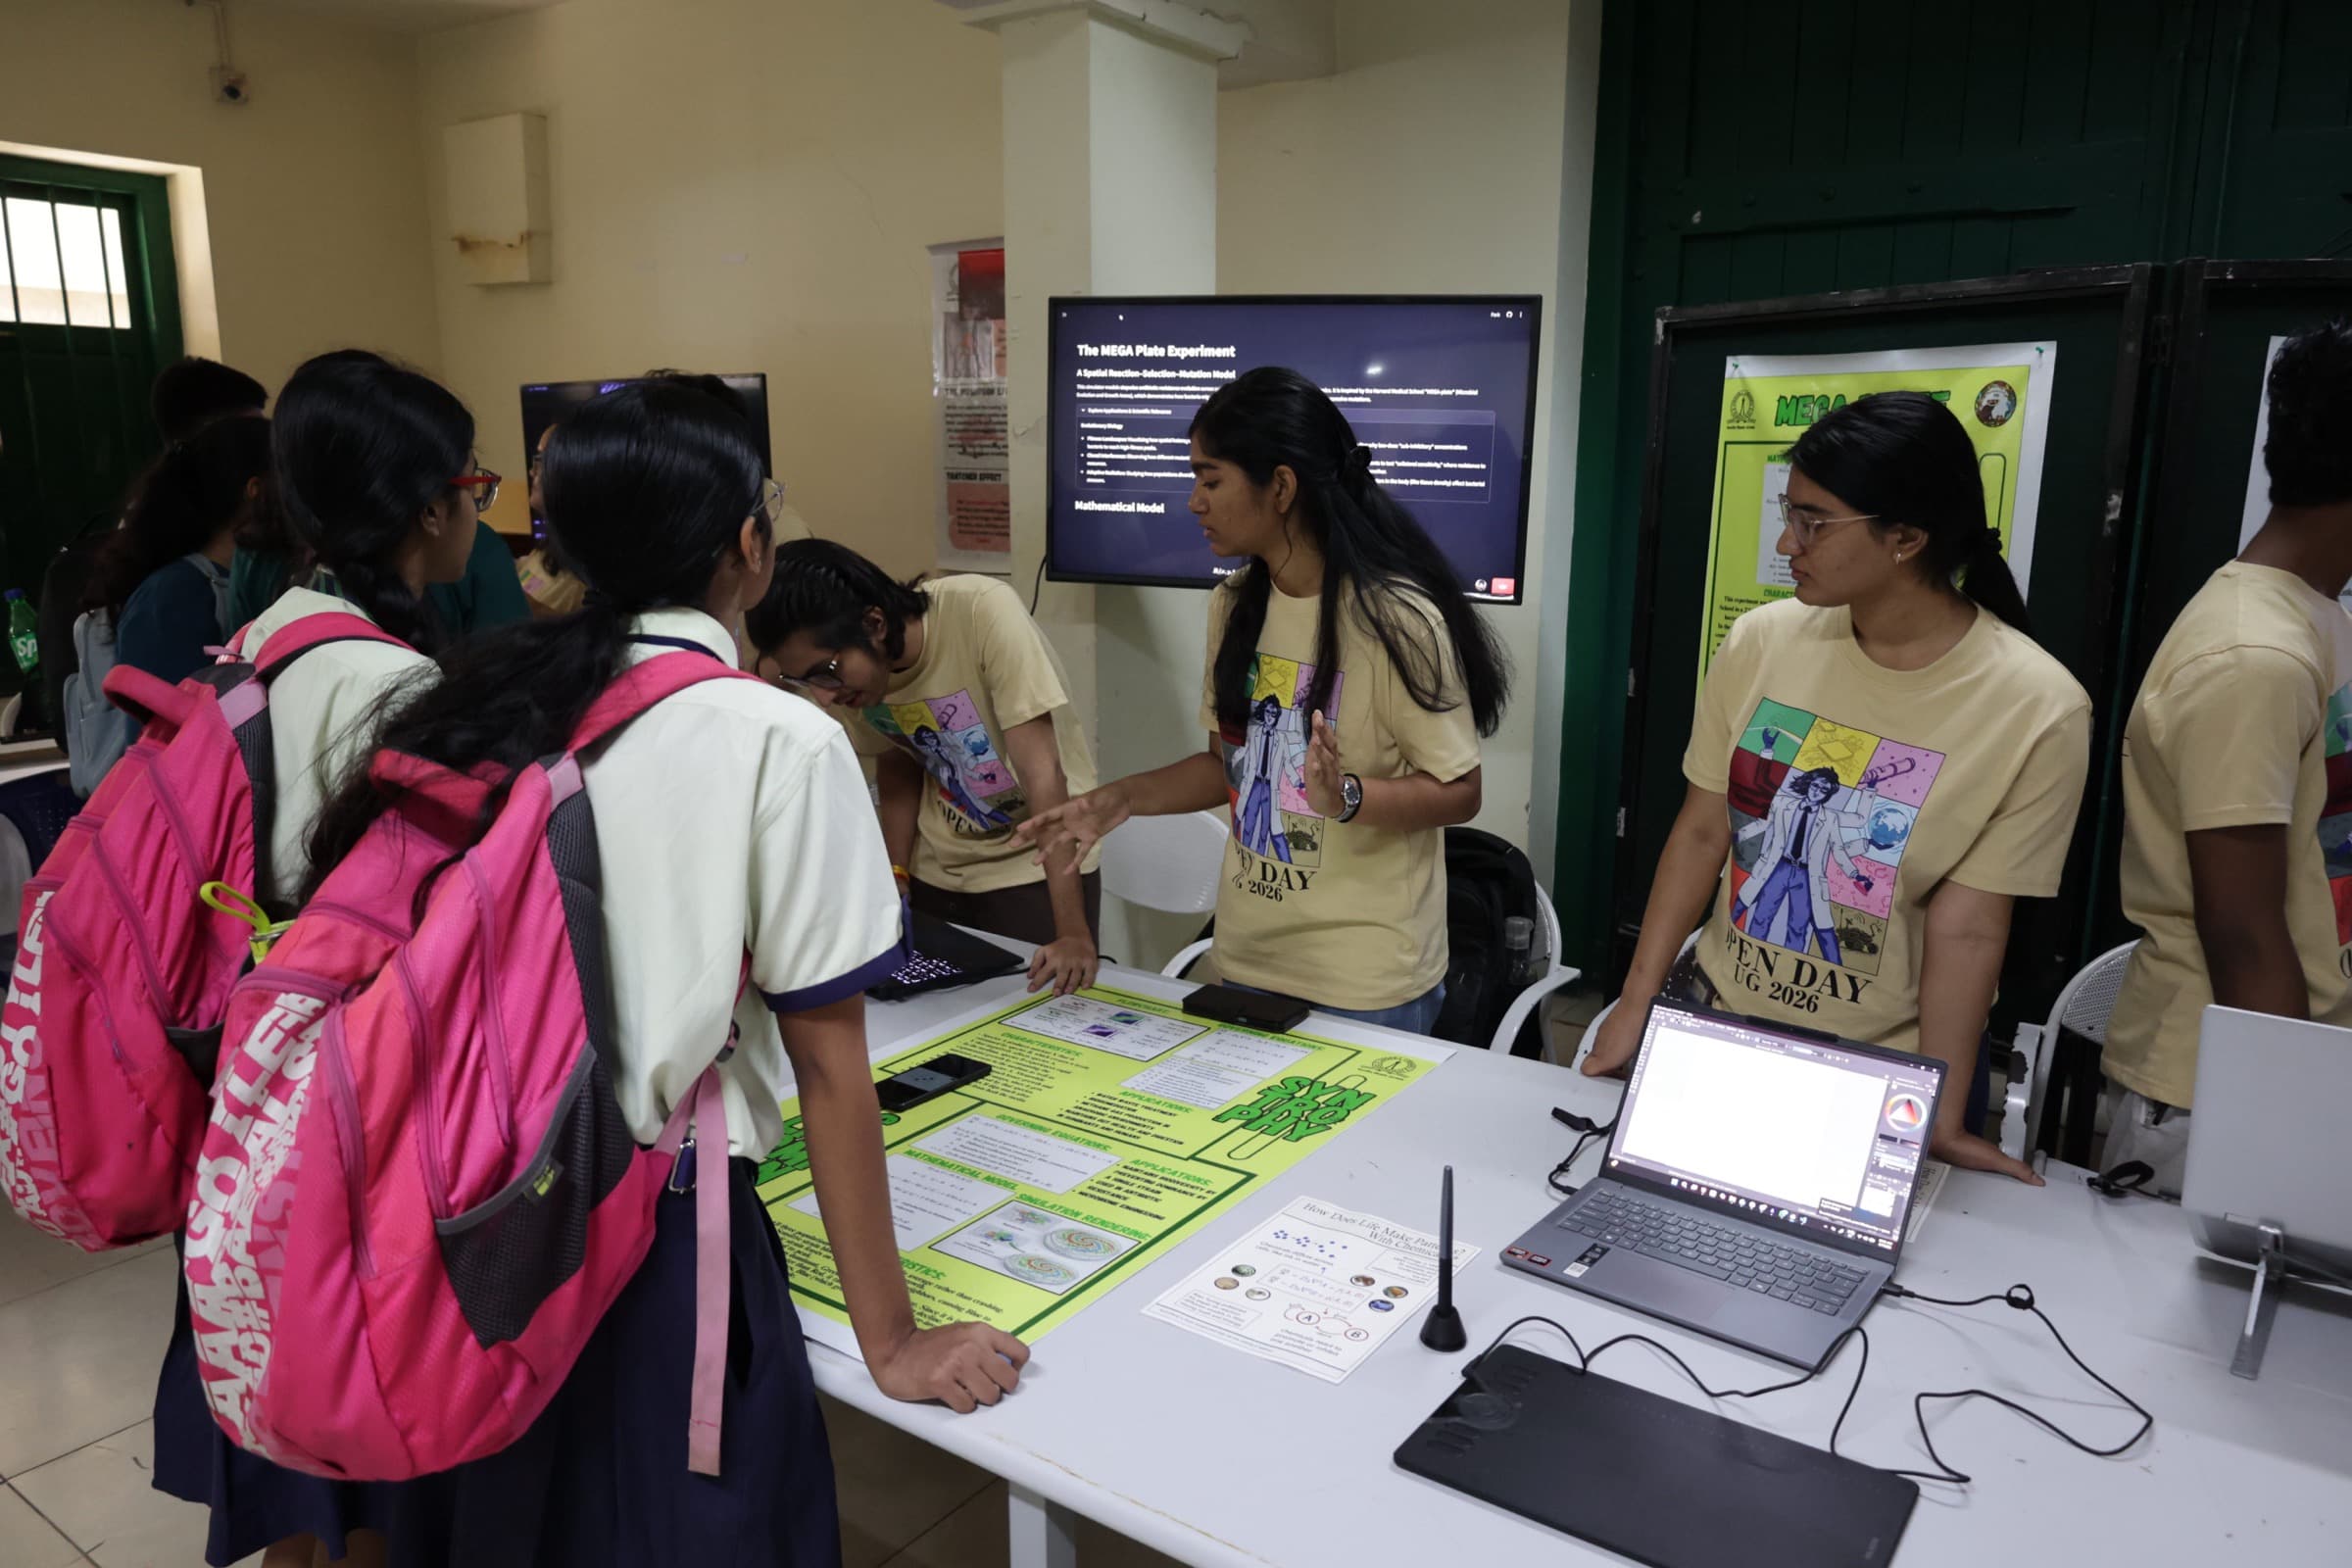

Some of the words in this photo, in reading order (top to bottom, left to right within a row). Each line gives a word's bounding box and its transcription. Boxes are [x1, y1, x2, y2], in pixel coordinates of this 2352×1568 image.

[1077, 344, 1100, 357] The
[1101, 345, 1134, 357] MEGA
[1136, 344, 1165, 357] Plate
[1167, 345, 1237, 360] Experiment
[1076, 368, 1083, 377] A
[1083, 369, 1107, 378] Spatial
[1075, 501, 1135, 512] Mathematical
[1137, 503, 1164, 514] Model
[17, 637, 37, 658] Sp
[1259, 860, 1317, 892] DAY
[1249, 880, 1283, 903] 2026
[1734, 963, 1761, 993] UG
[1768, 982, 1819, 1014] 2026
[1791, 956, 1873, 1004] DAY
[1248, 1086, 1351, 1126] TRO
[1275, 1076, 1378, 1112] SYN
[1211, 1104, 1333, 1142] PHY
[980, 1175, 1022, 1189] MODEL
[1128, 1158, 1216, 1185] APPLICATIONS:
[1303, 1202, 1328, 1216] How
[1330, 1211, 1358, 1225] Does
[1358, 1219, 1381, 1232] Life
[1381, 1226, 1416, 1243] Make
[1368, 1230, 1394, 1246] With
